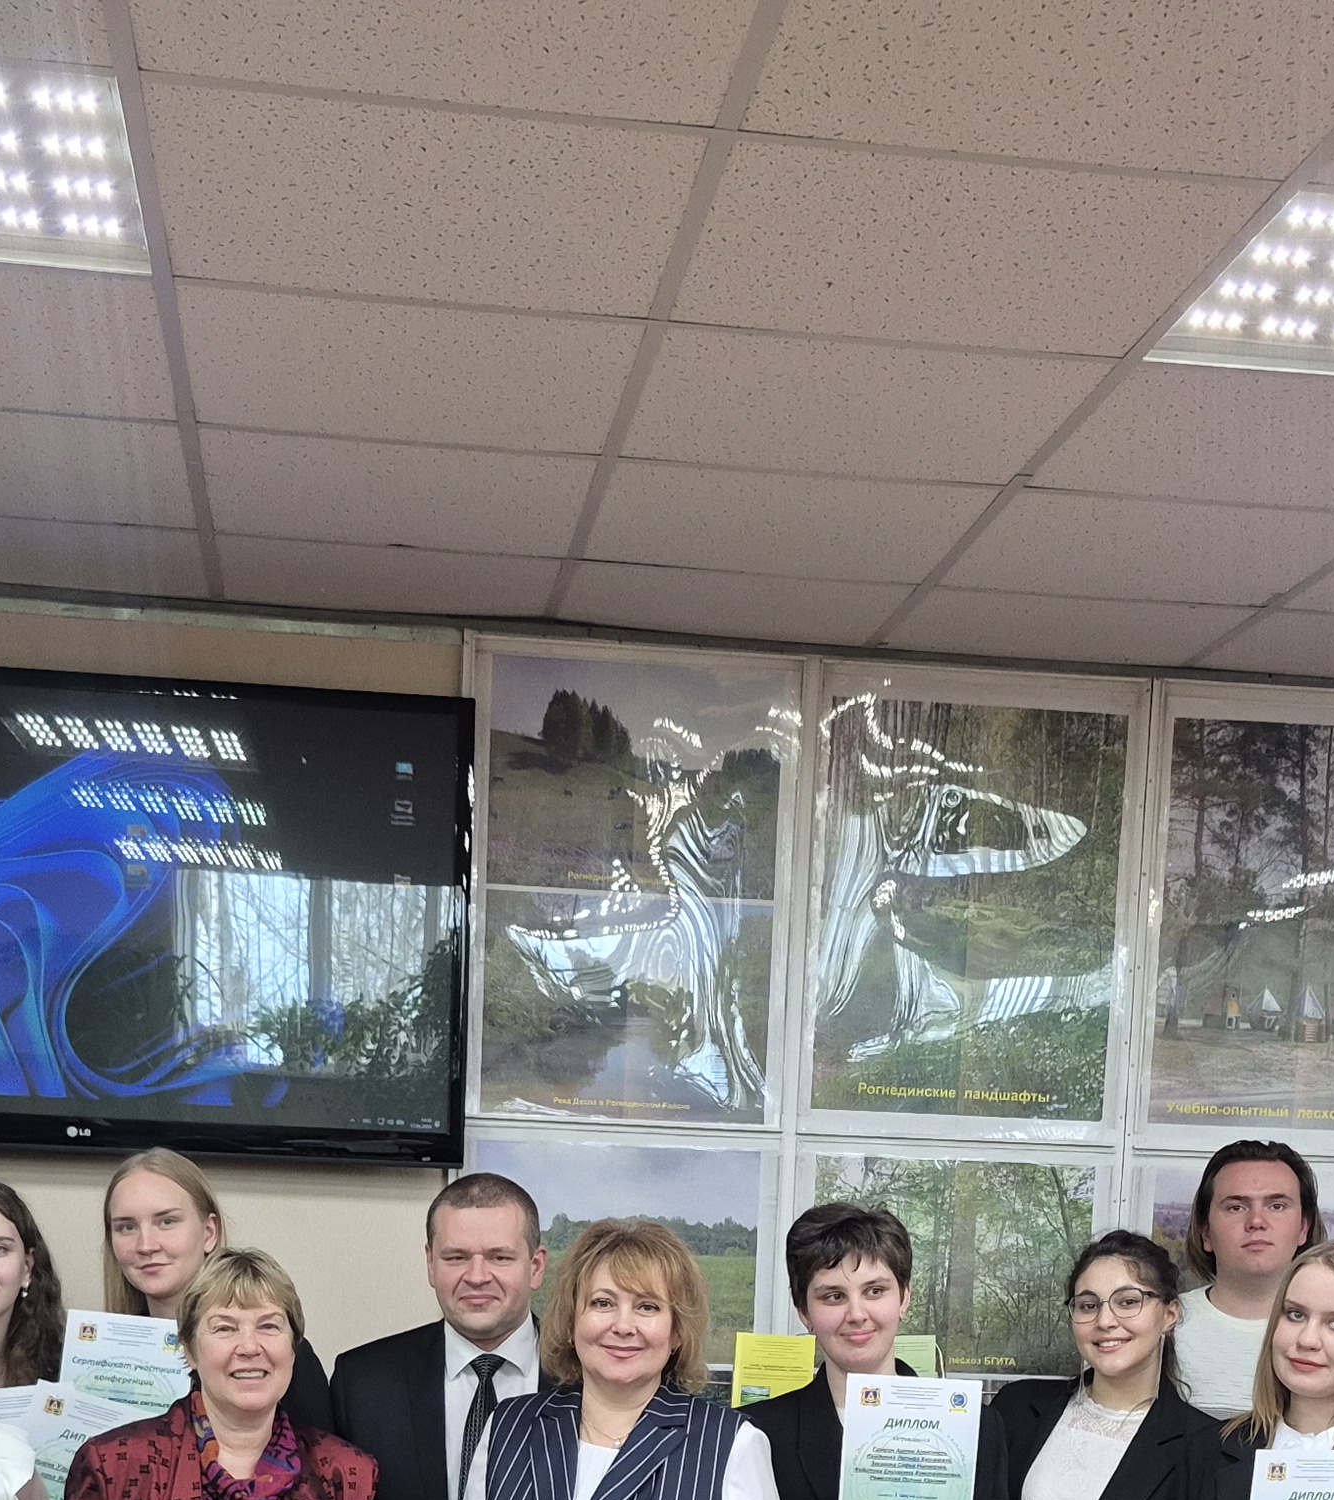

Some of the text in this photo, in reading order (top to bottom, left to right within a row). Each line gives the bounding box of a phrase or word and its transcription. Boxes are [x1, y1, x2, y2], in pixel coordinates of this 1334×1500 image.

[858, 1082, 1050, 1104] Рогнединские ландшафты
[1167, 1102, 1288, 1118] Учебно-опытный
[72, 1356, 182, 1375] Сертификат участника
[984, 1356, 1017, 1366] БГИТА
[94, 1374, 155, 1387] конференции
[884, 1418, 940, 1430] ДИПЛОМ
[59, 1429, 87, 1443] ДИП
